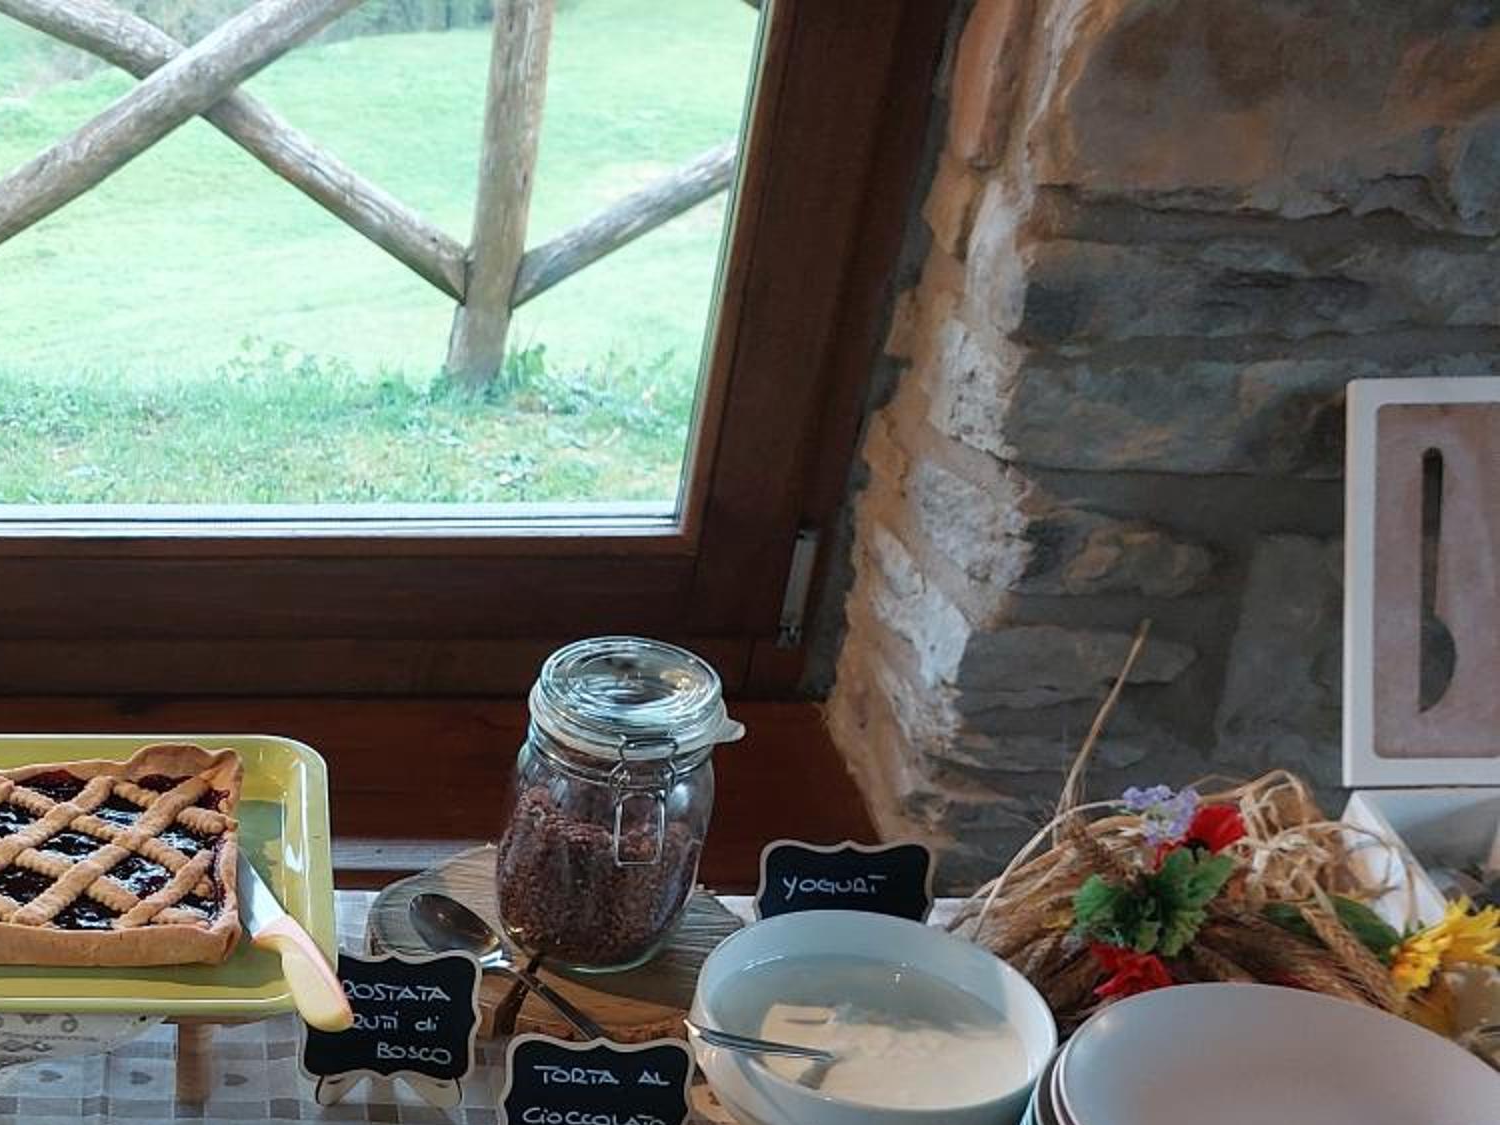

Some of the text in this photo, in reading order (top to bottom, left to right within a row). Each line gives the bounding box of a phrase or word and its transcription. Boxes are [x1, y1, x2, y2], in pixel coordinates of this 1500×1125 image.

[341, 979, 452, 1002] ROSTATA
[414, 1015, 440, 1032] di
[376, 1041, 452, 1065] BOSCO
[533, 1065, 671, 1087] TORTA AL
